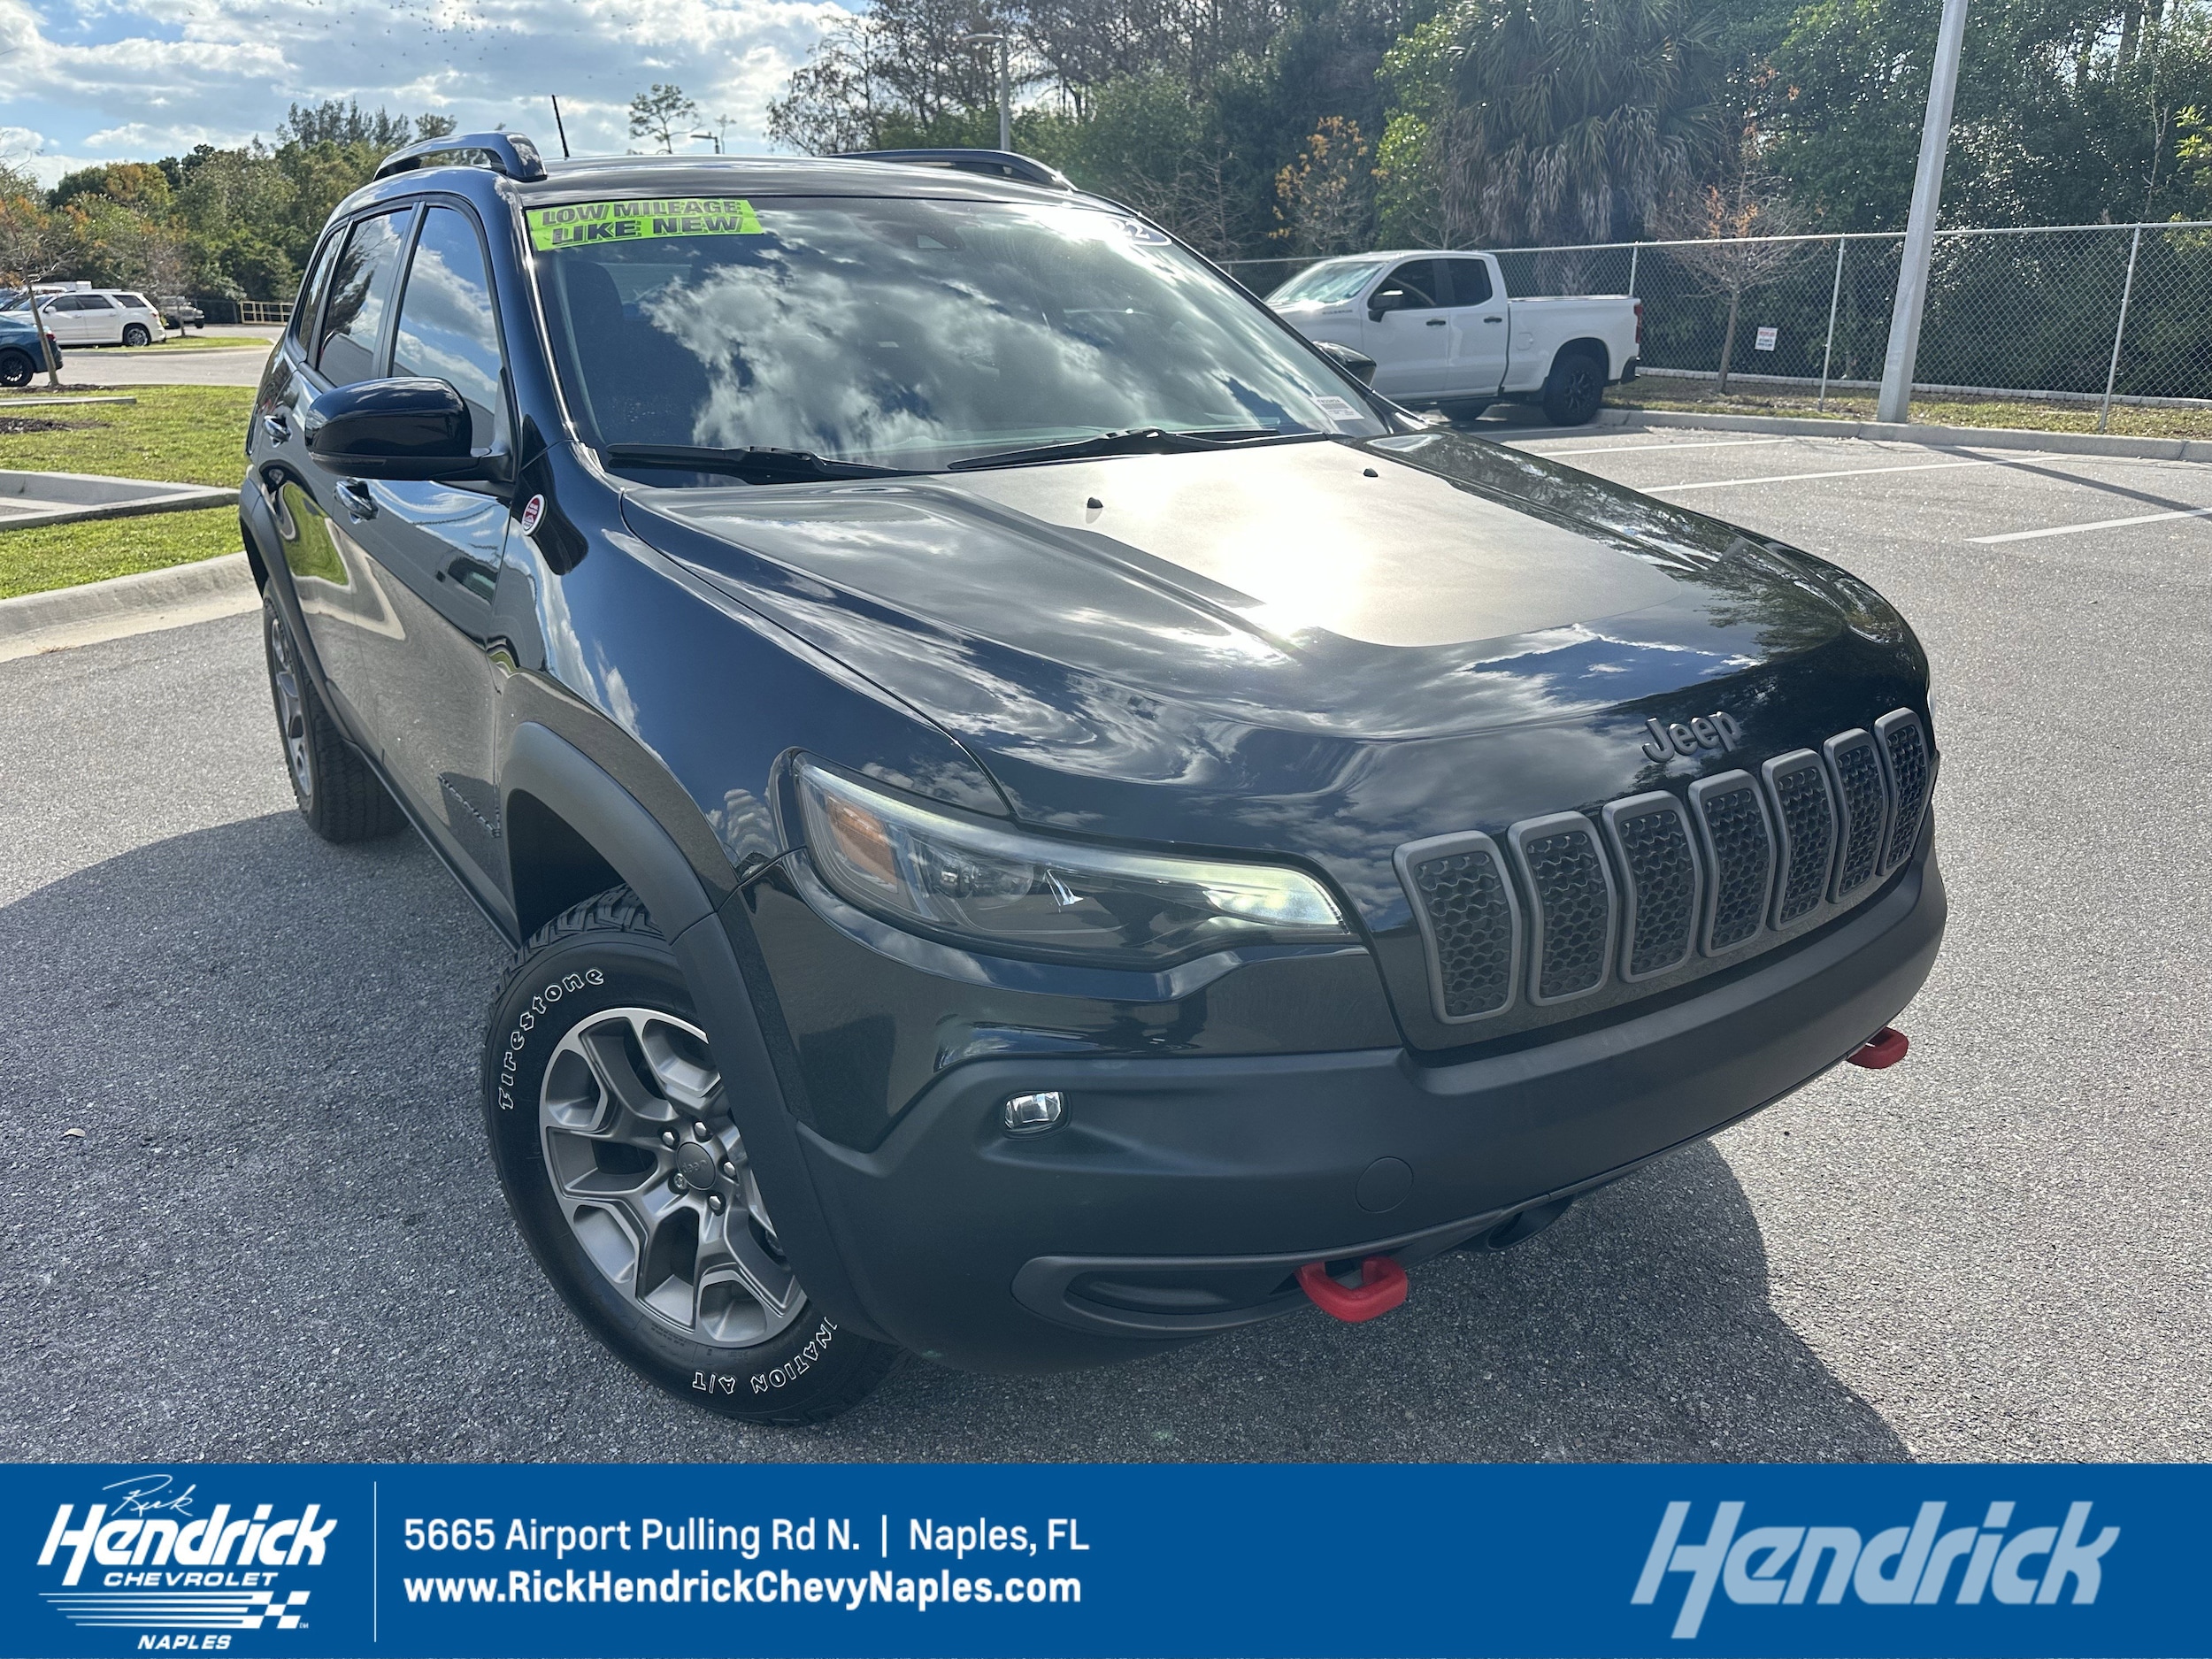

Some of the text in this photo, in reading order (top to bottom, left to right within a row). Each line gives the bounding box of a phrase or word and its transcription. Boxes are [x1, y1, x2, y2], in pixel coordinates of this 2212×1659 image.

[542, 201, 741, 226] LOW MILEAGE
[552, 216, 743, 245] LIKE NEW
[1642, 711, 1741, 763] Jeep
[498, 969, 604, 1110] Firestone
[692, 1371, 736, 1394] A/T
